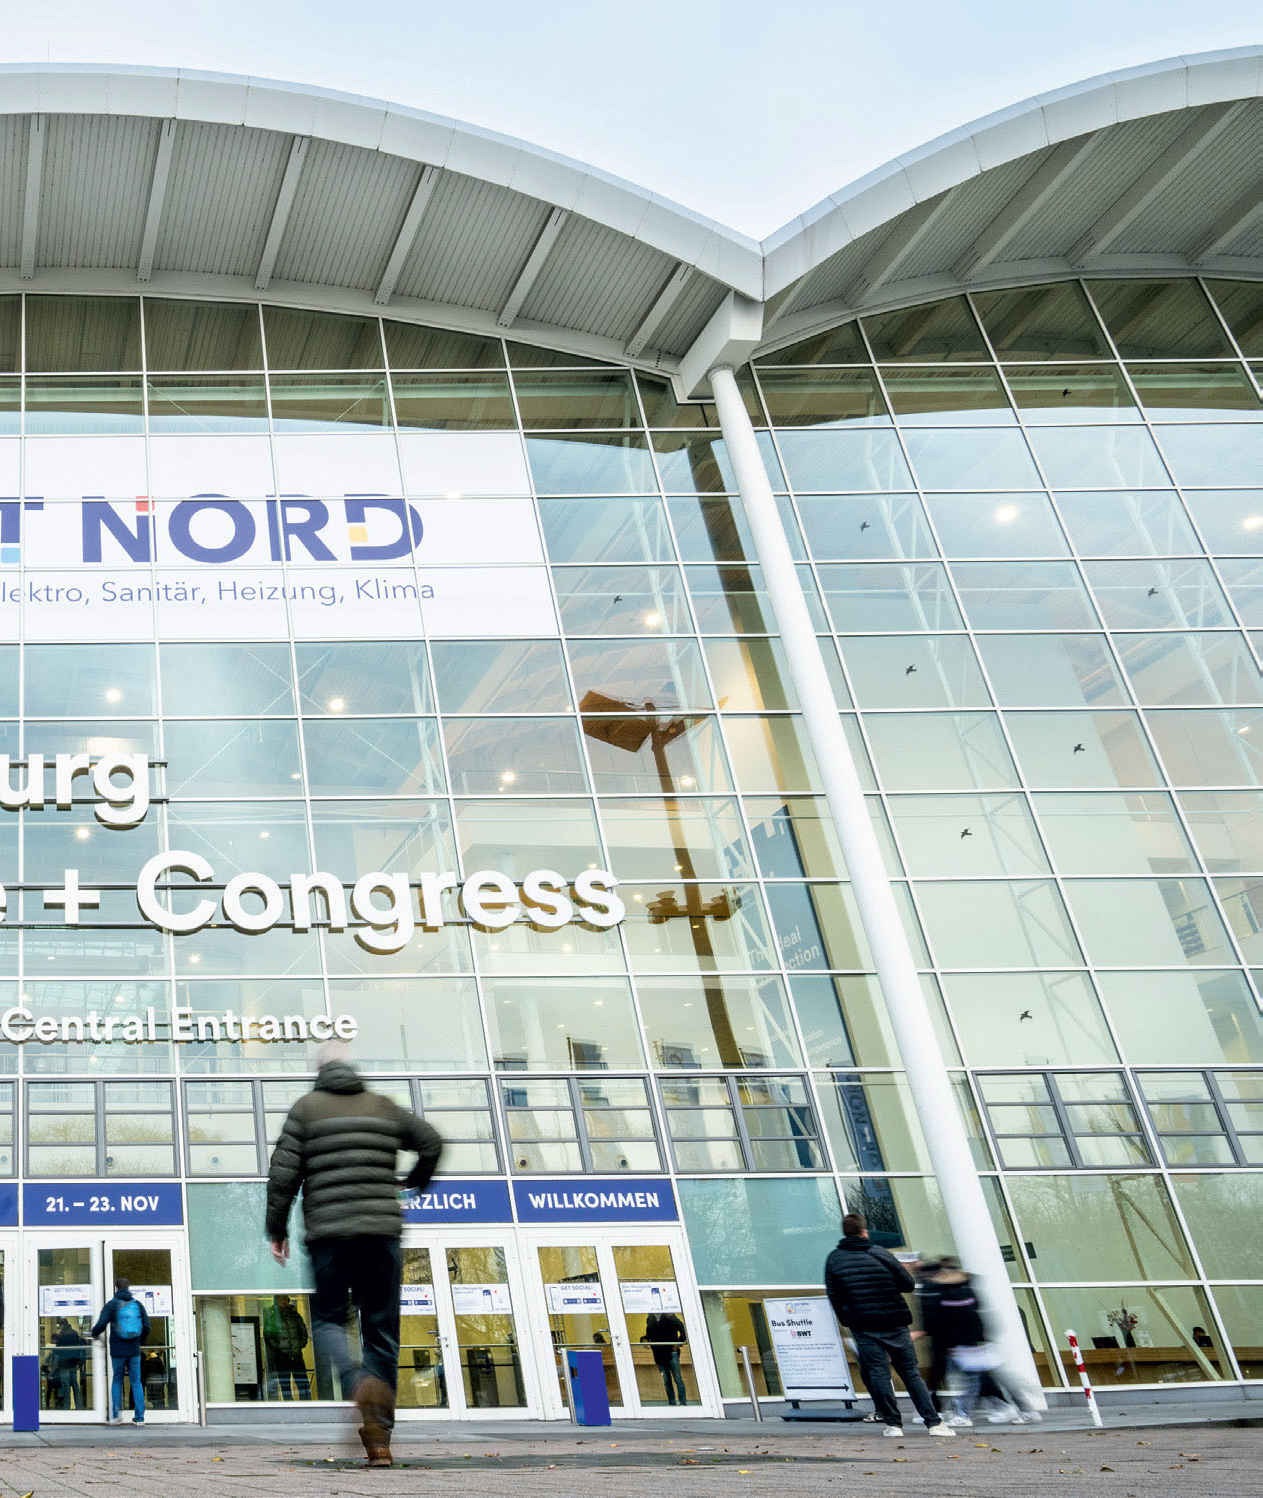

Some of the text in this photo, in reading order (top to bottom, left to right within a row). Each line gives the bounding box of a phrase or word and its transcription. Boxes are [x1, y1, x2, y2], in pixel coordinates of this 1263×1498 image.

[82, 493, 424, 564] NORD
[101, 580, 205, 606] Sanitär,
[218, 579, 345, 607] Heizung,
[355, 578, 435, 600] Klima
[43, 869, 100, 925] +
[137, 850, 626, 952] Congress
[1, 1006, 155, 1043] Central
[172, 1006, 358, 1042] Entrance
[46, 1197, 69, 1212] 21.
[90, 1197, 116, 1212] 23.
[121, 1196, 159, 1211] NOV
[399, 1193, 476, 1210] ERZLICH
[529, 1191, 660, 1209] WILLKOMMEN
[771, 1318, 813, 1327] Bus Shuttle
